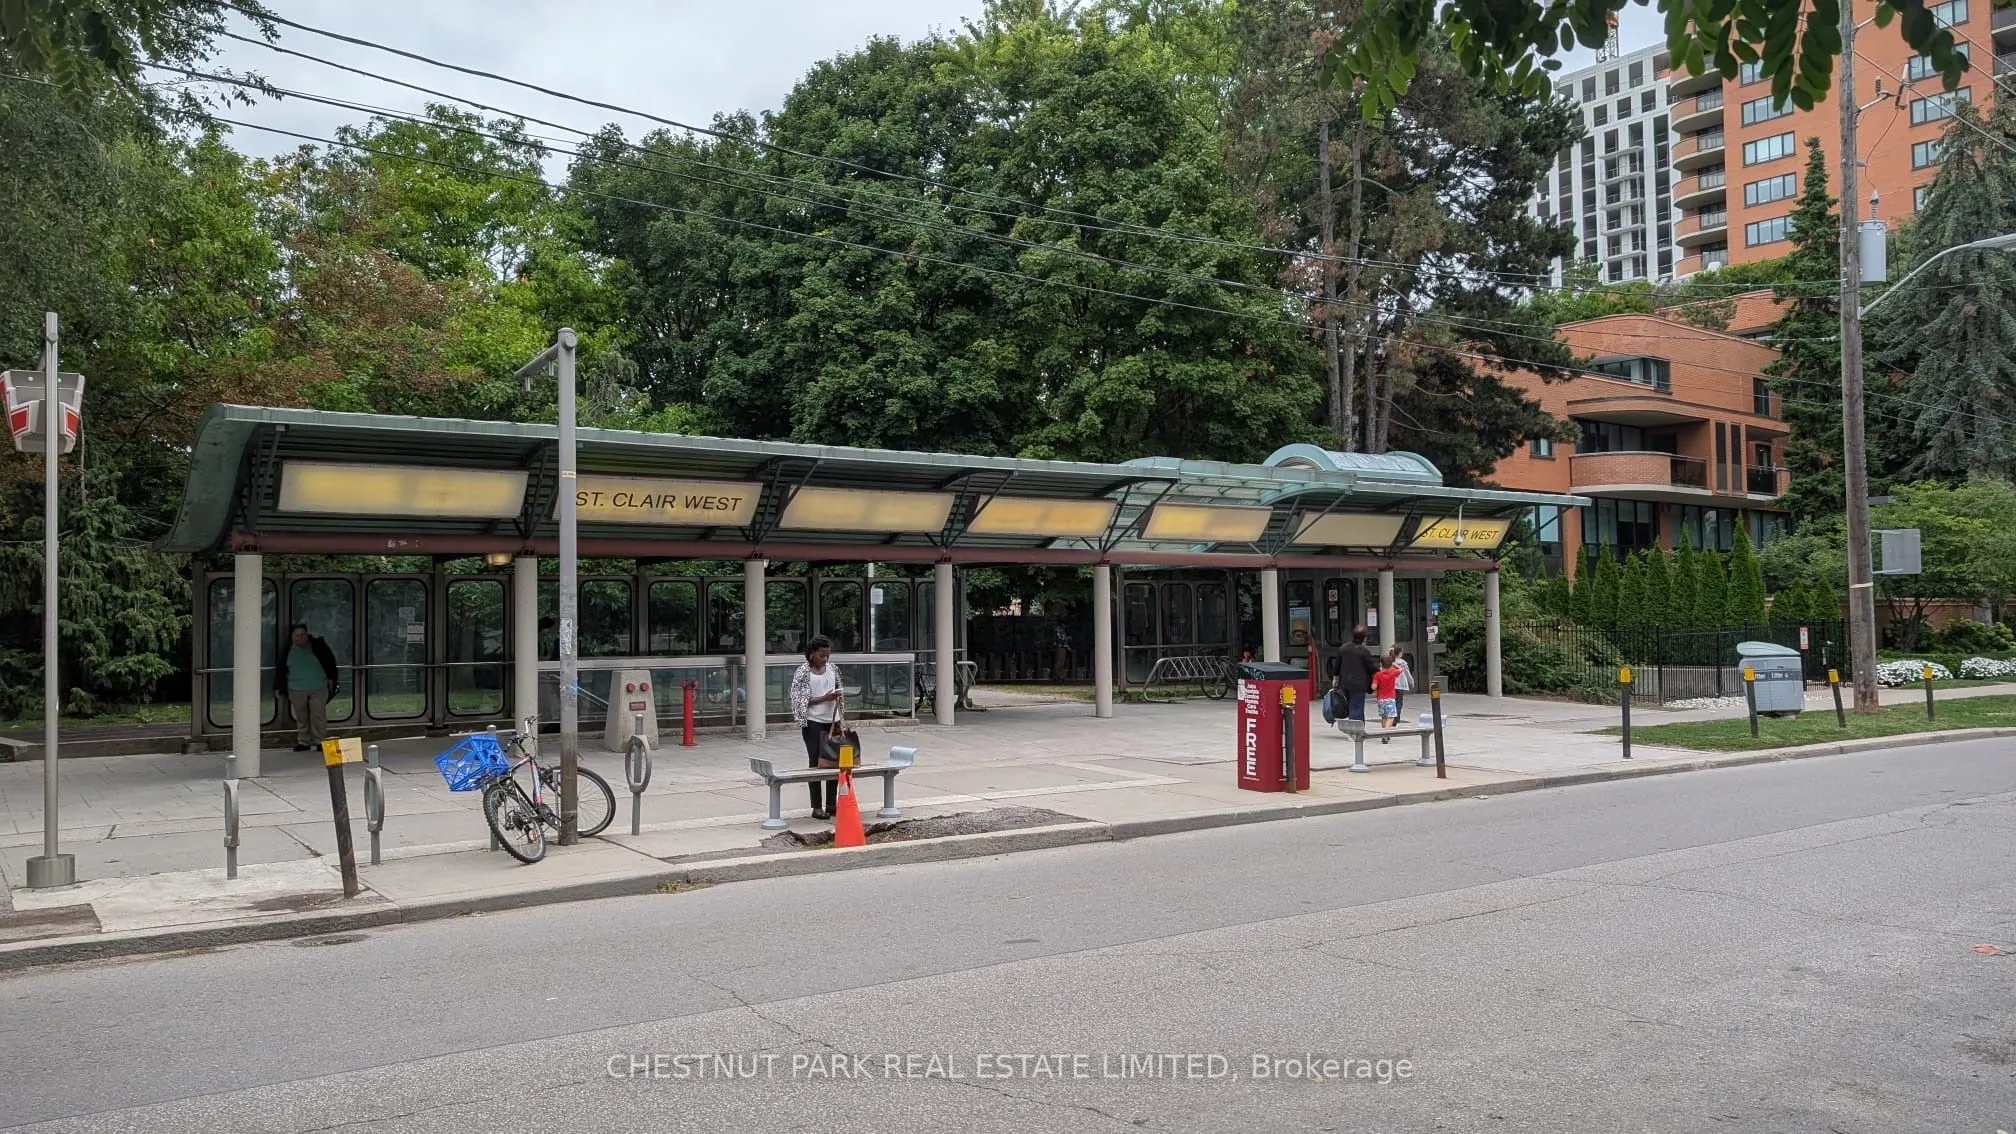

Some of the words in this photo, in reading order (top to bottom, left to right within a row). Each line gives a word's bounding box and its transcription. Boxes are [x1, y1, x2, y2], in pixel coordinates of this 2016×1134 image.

[575, 491, 604, 507] ST.
[612, 492, 676, 509] CLAIR
[684, 495, 743, 512] WEST
[1470, 529, 1499, 540] WEST
[1246, 718, 1256, 776] FREE
